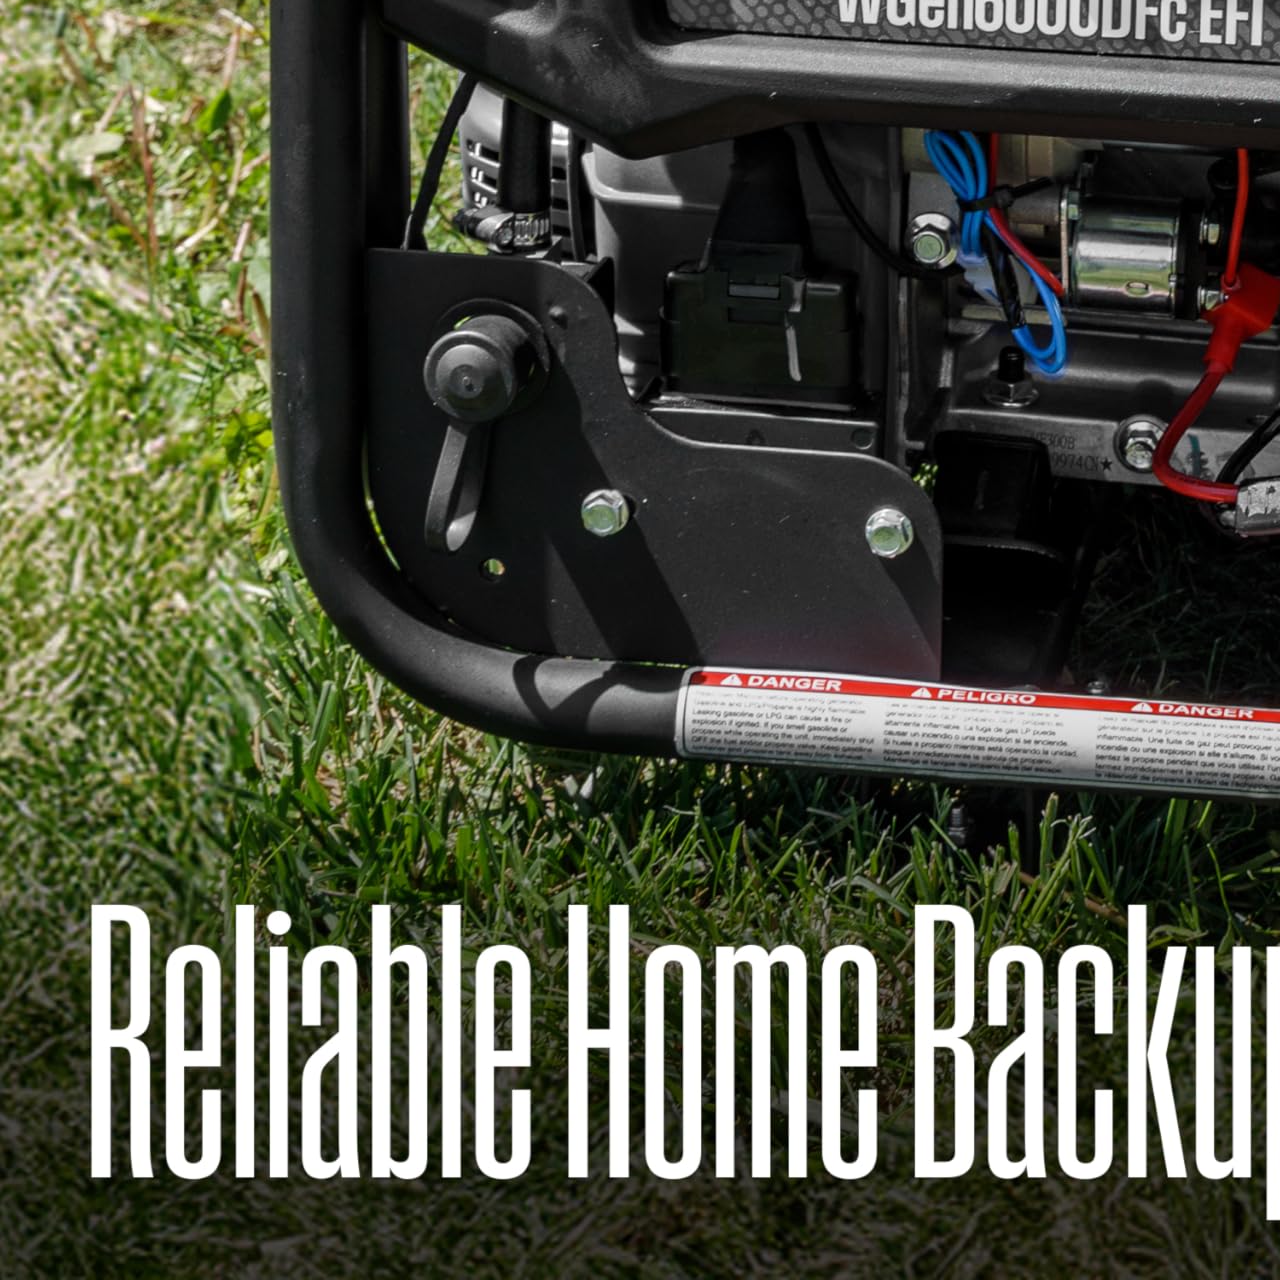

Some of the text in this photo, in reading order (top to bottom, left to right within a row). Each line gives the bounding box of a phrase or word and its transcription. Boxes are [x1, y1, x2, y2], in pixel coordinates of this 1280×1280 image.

[748, 677, 842, 692] DANGER
[938, 689, 1036, 704] PELIGRO
[1158, 704, 1254, 718] DANGER
